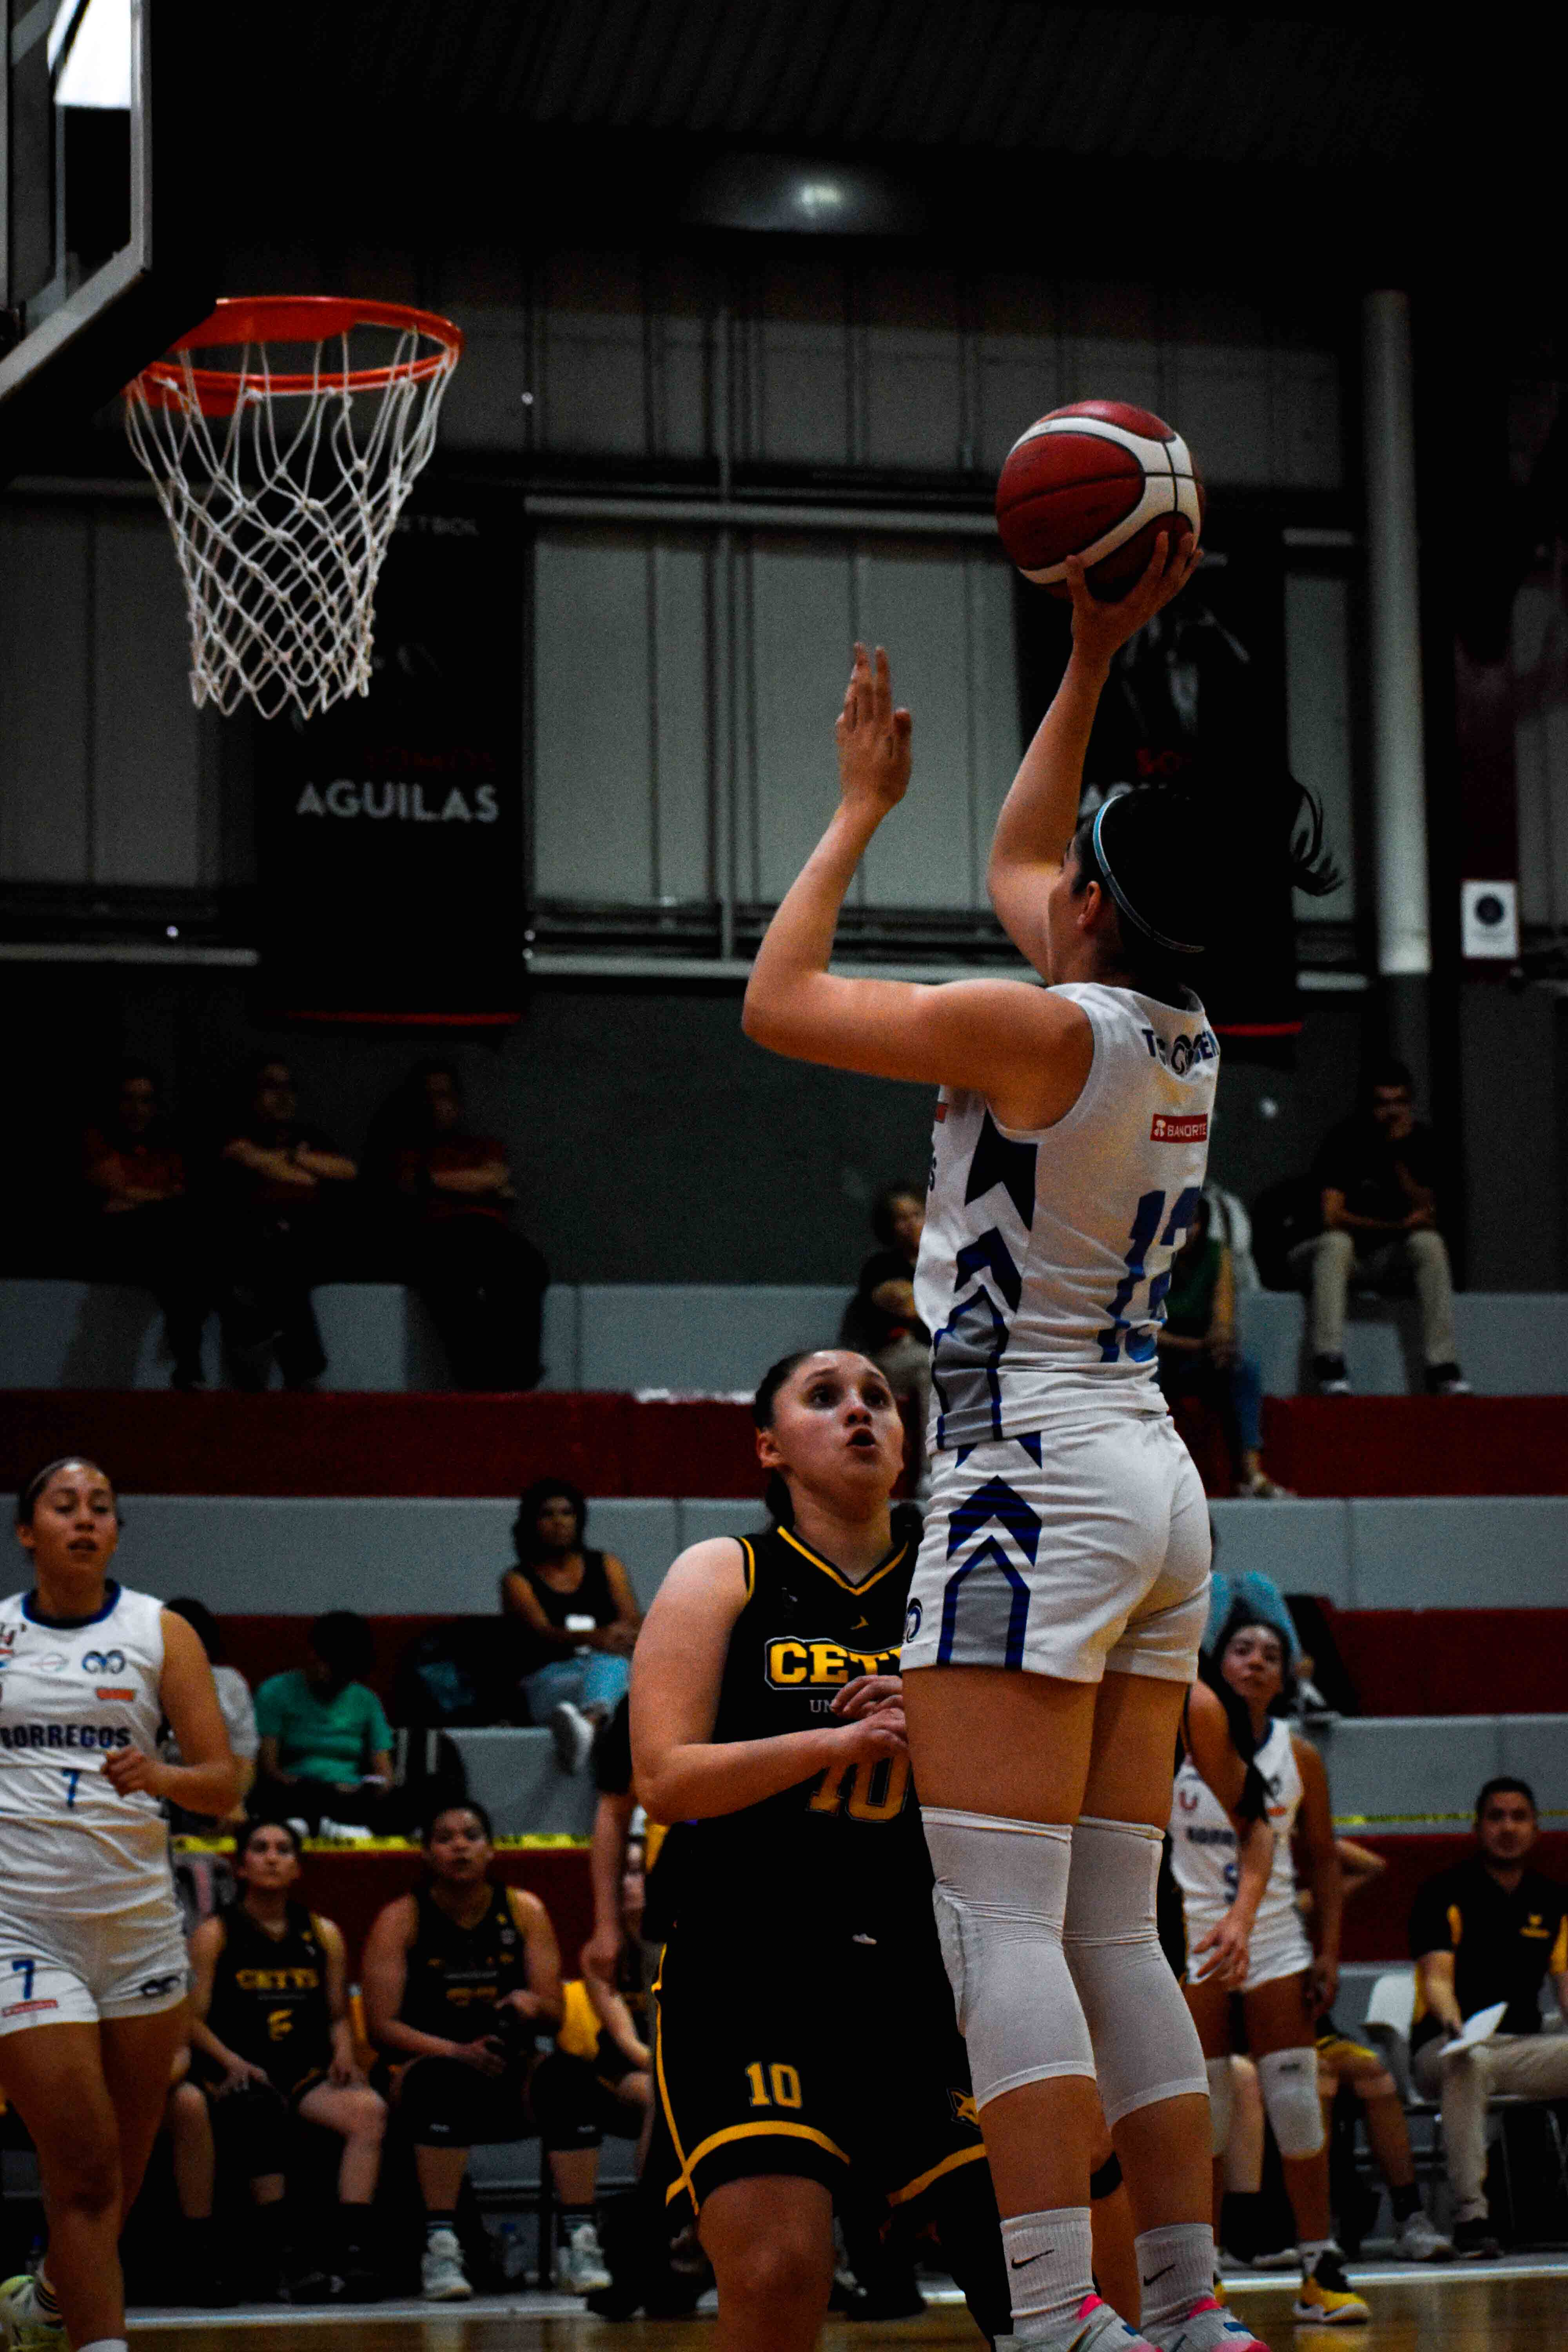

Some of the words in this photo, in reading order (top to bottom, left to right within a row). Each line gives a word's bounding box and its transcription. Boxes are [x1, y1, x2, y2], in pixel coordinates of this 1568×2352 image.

[295, 778, 502, 824] AGUILAS
[62, 1768, 81, 1806] 7
[12, 1960, 34, 1999] 7
[744, 2061, 803, 2110] 10
